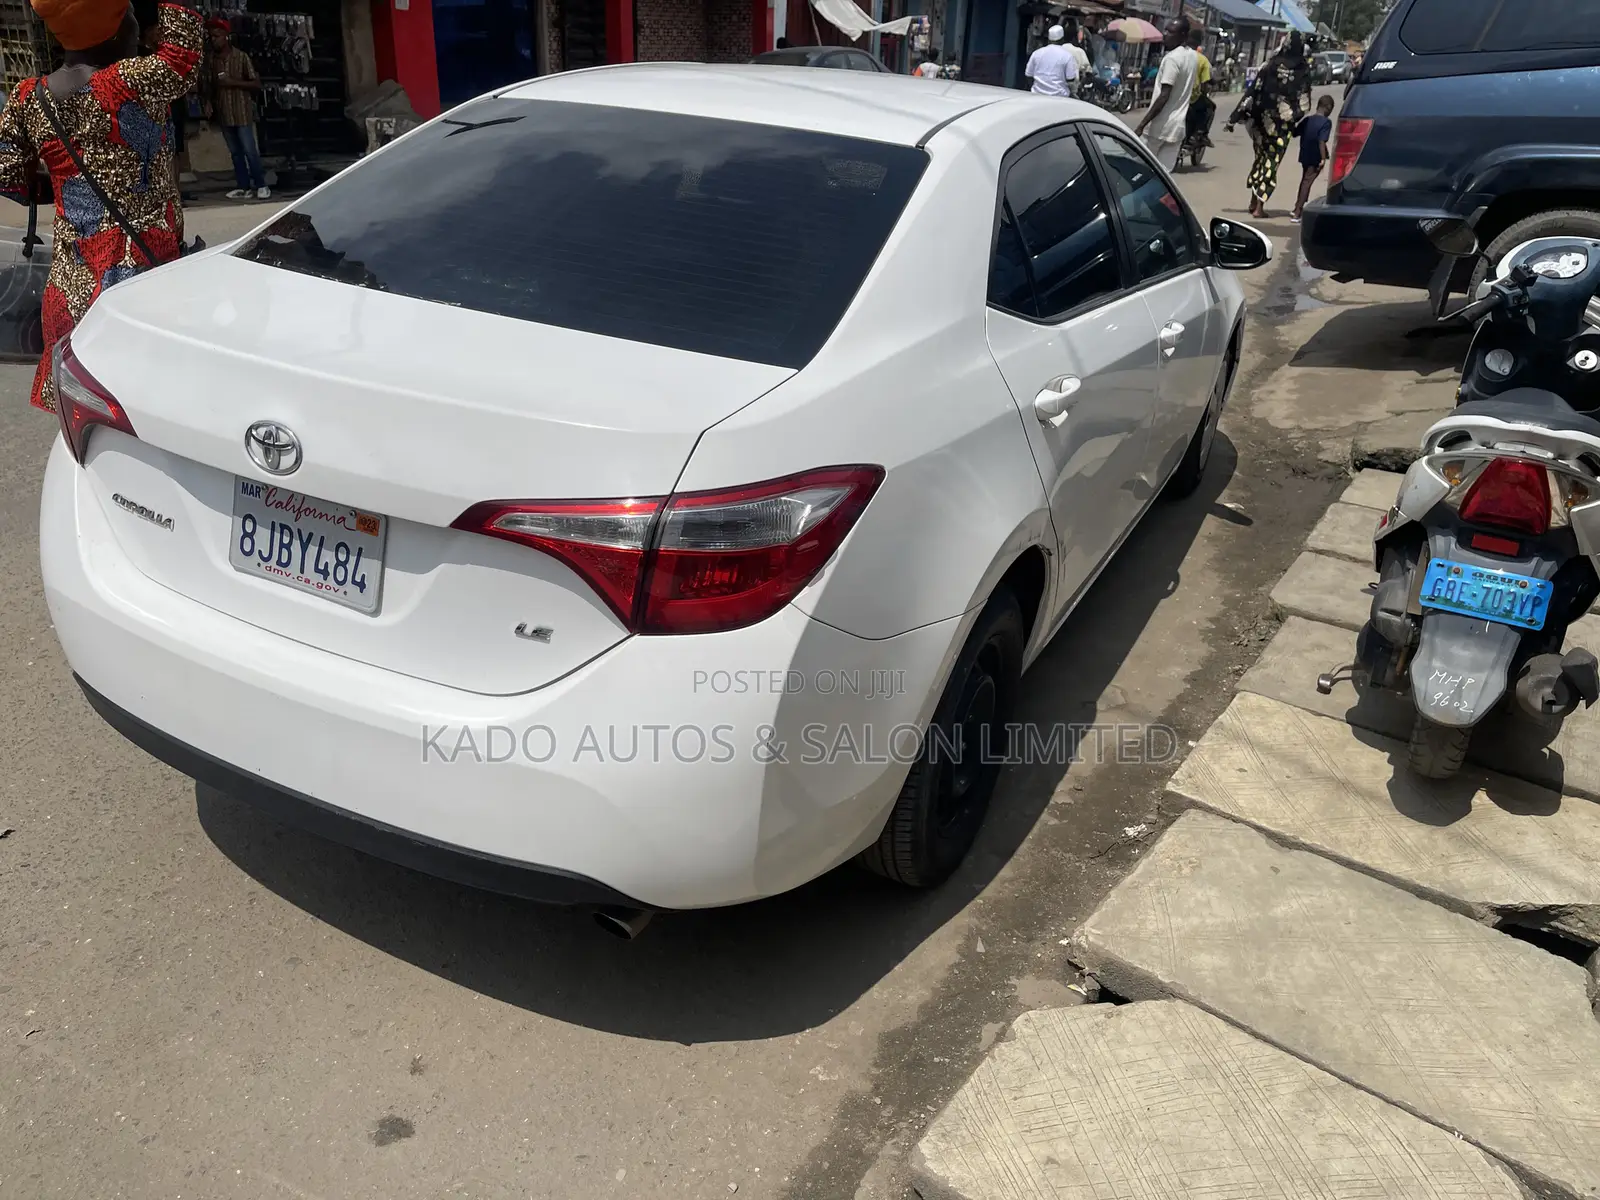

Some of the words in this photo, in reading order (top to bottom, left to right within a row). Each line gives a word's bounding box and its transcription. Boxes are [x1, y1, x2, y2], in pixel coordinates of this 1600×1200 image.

[241, 482, 261, 499] MAR
[264, 487, 356, 531] California
[239, 513, 367, 593] 8JBY484
[264, 565, 340, 593] dmv.ca.gov
